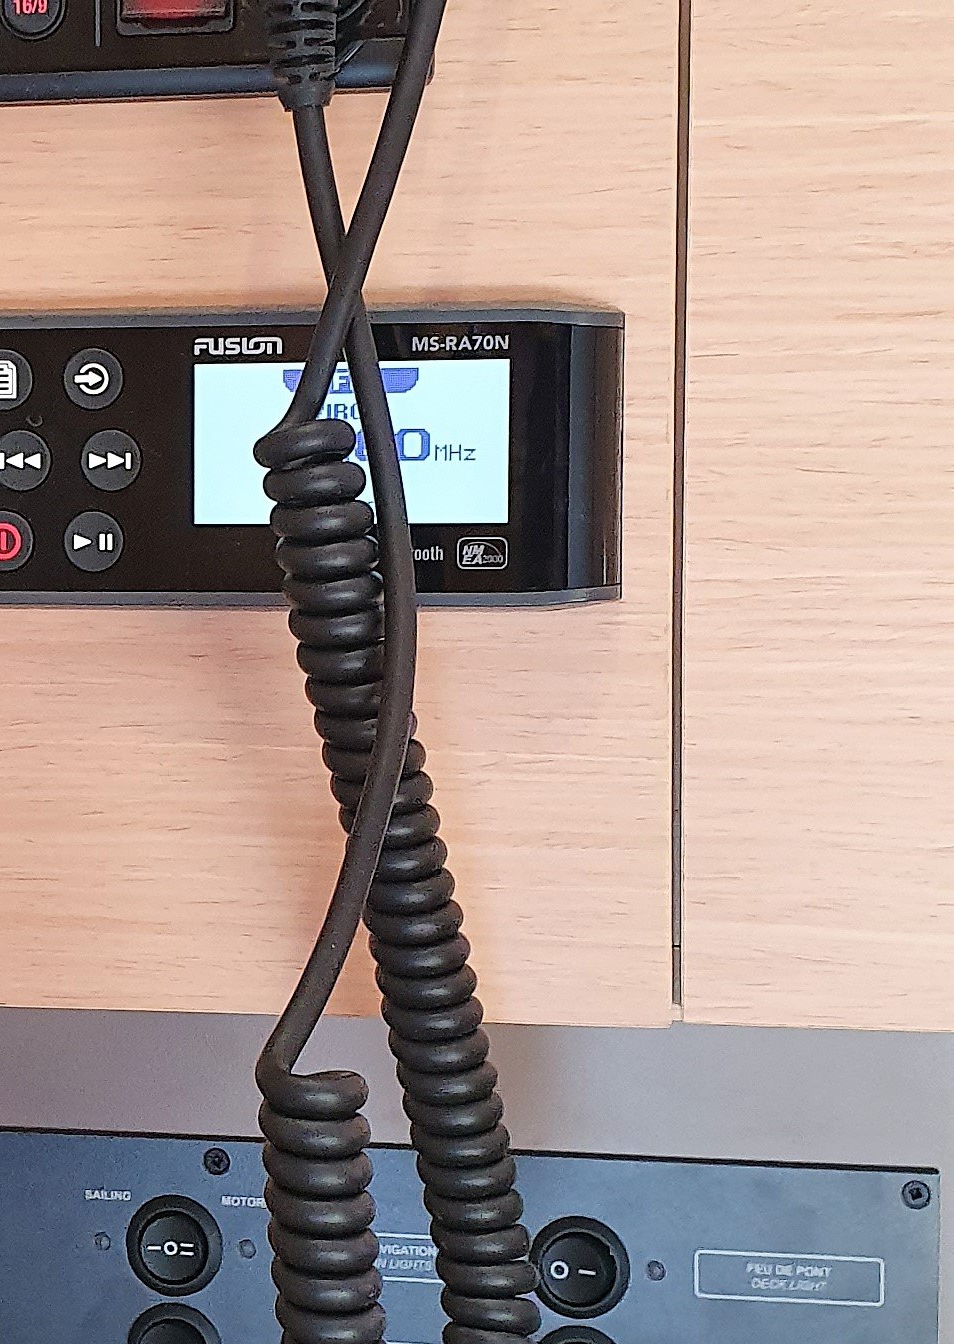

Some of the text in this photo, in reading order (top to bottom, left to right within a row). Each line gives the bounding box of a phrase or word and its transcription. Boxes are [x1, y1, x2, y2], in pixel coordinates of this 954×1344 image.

[412, 334, 510, 353] MS-RA70N
[434, 444, 477, 462] MHz
[84, 1189, 132, 1202] SAILING
